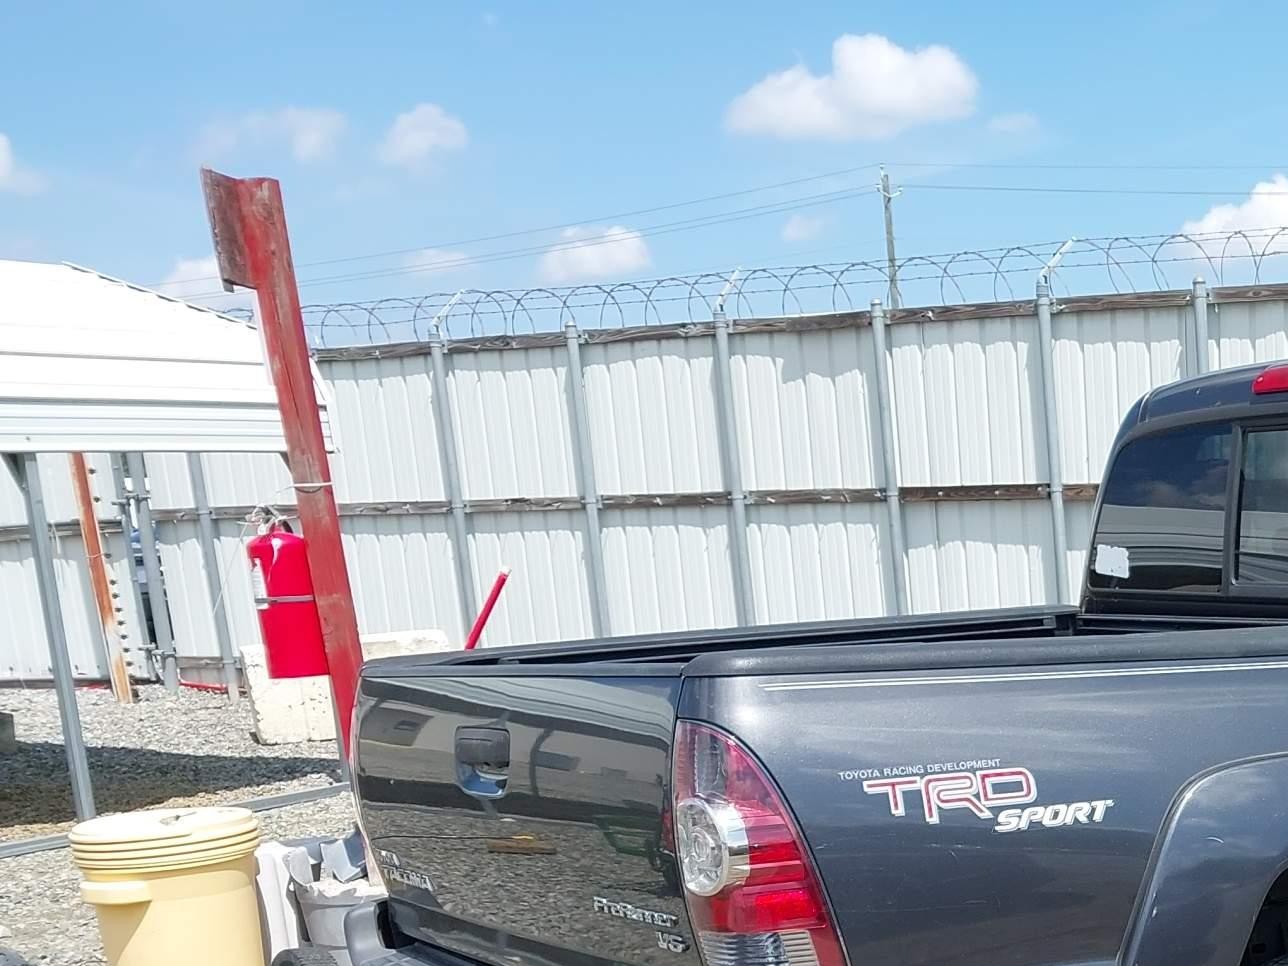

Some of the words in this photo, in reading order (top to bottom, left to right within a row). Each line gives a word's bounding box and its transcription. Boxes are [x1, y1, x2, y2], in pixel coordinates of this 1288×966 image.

[838, 767, 881, 781] TOYOTA
[883, 764, 924, 776] RACING
[927, 758, 1001, 772] DEVELOPMENT
[863, 767, 1036, 824] TRD
[992, 799, 1114, 832] SPORT
